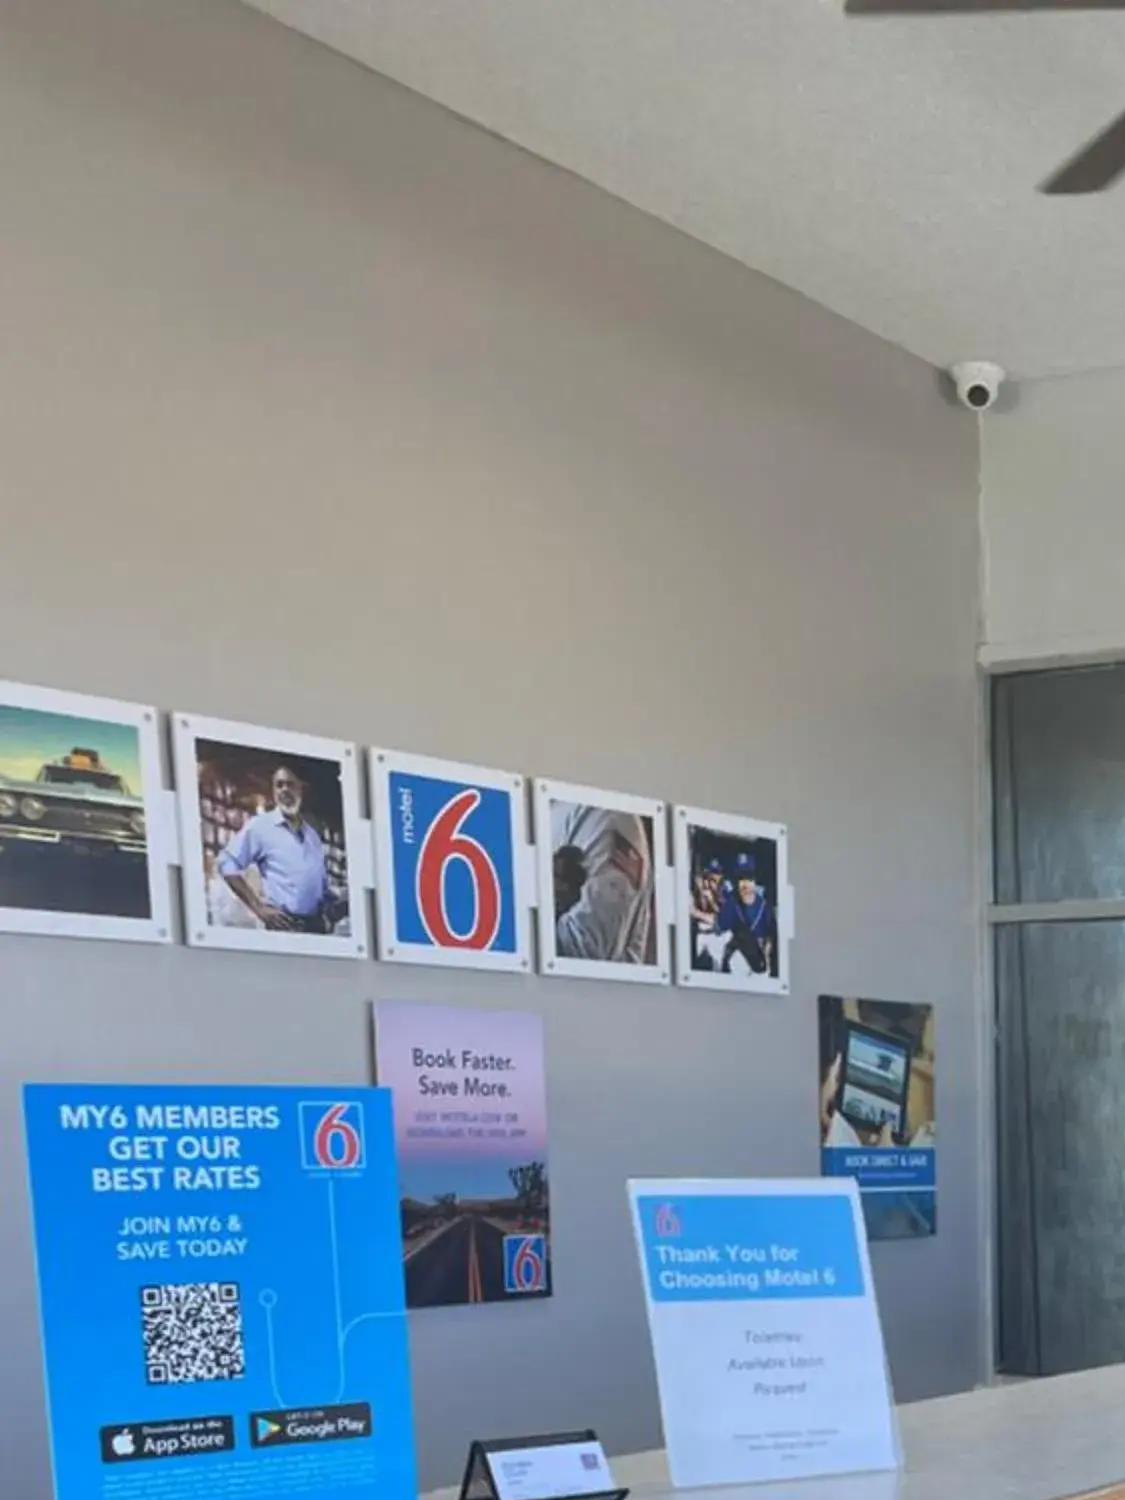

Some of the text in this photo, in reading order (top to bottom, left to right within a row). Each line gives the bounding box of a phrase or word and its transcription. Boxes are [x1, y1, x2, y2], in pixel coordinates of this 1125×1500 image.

[398, 787, 415, 845] motel
[415, 788, 501, 951] 6
[411, 1048, 516, 1071] Book Faster.
[418, 1075, 512, 1098] Save More.
[59, 1104, 281, 1130] MY6 MEMBERS
[313, 1101, 360, 1168] 6
[108, 1135, 241, 1161] GET OUR
[92, 1166, 261, 1192] BEST RATES
[118, 1214, 243, 1236] JOIN MY6 &
[117, 1238, 248, 1261] SAVE TODAY
[655, 1243, 798, 1265] Thank You for
[512, 1235, 542, 1292] 6
[658, 1268, 760, 1290] Choosing
[764, 1268, 818, 1287] Motel
[286, 1416, 366, 1439] Google Play
[143, 1432, 225, 1454] App Store
